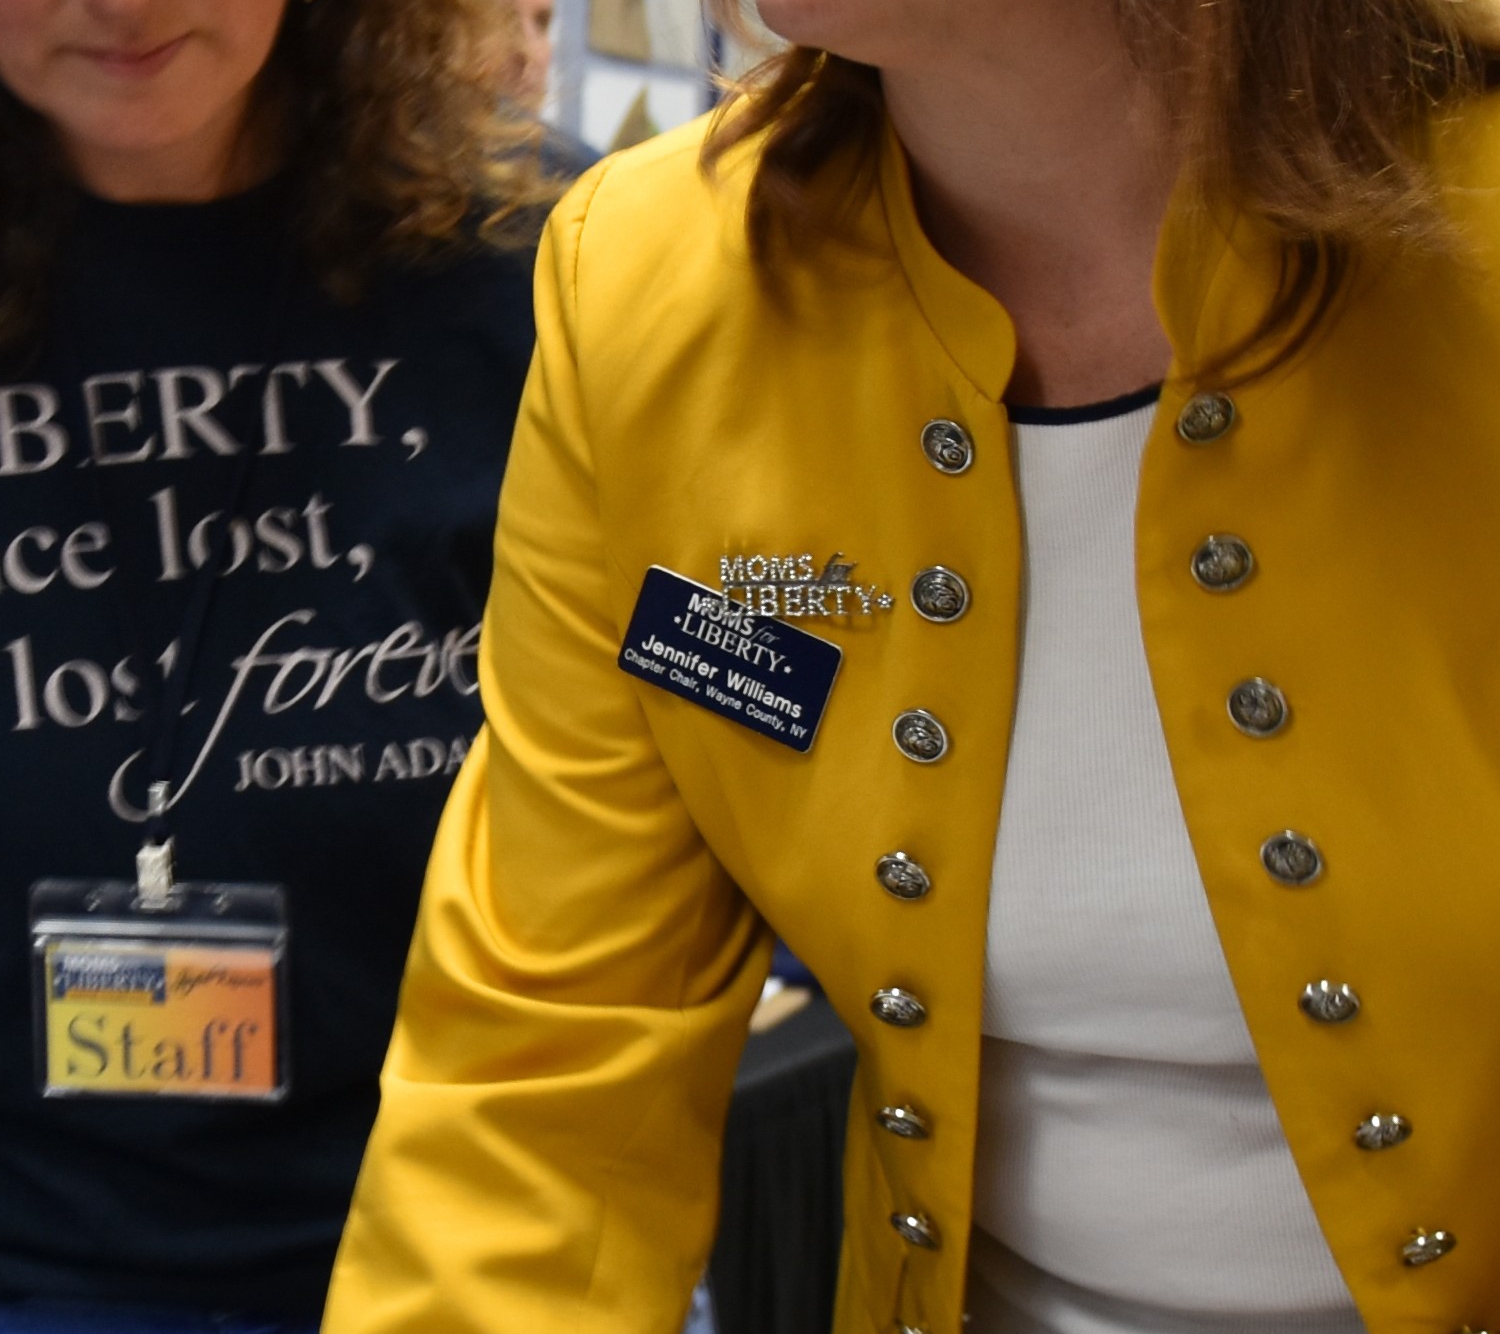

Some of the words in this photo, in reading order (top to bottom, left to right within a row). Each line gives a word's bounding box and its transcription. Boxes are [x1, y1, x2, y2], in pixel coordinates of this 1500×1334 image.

[152, 486, 376, 583] lost,
[719, 553, 815, 583] MOMS
[687, 592, 755, 636] MOMS
[722, 584, 877, 616] LIBERTY
[641, 634, 719, 680] Jennifer
[727, 669, 802, 718] Williams
[680, 612, 787, 673] LIBERTY
[6, 632, 199, 733] los
[108, 607, 482, 823] foreve
[624, 647, 666, 675] Chapter
[669, 669, 700, 693] Chair,
[706, 685, 742, 710] Wayne
[745, 704, 785, 732] County,
[790, 722, 808, 740] NY
[234, 741, 365, 792] JOHN
[374, 734, 476, 783] ADA
[67, 1011, 260, 1084] Staff
